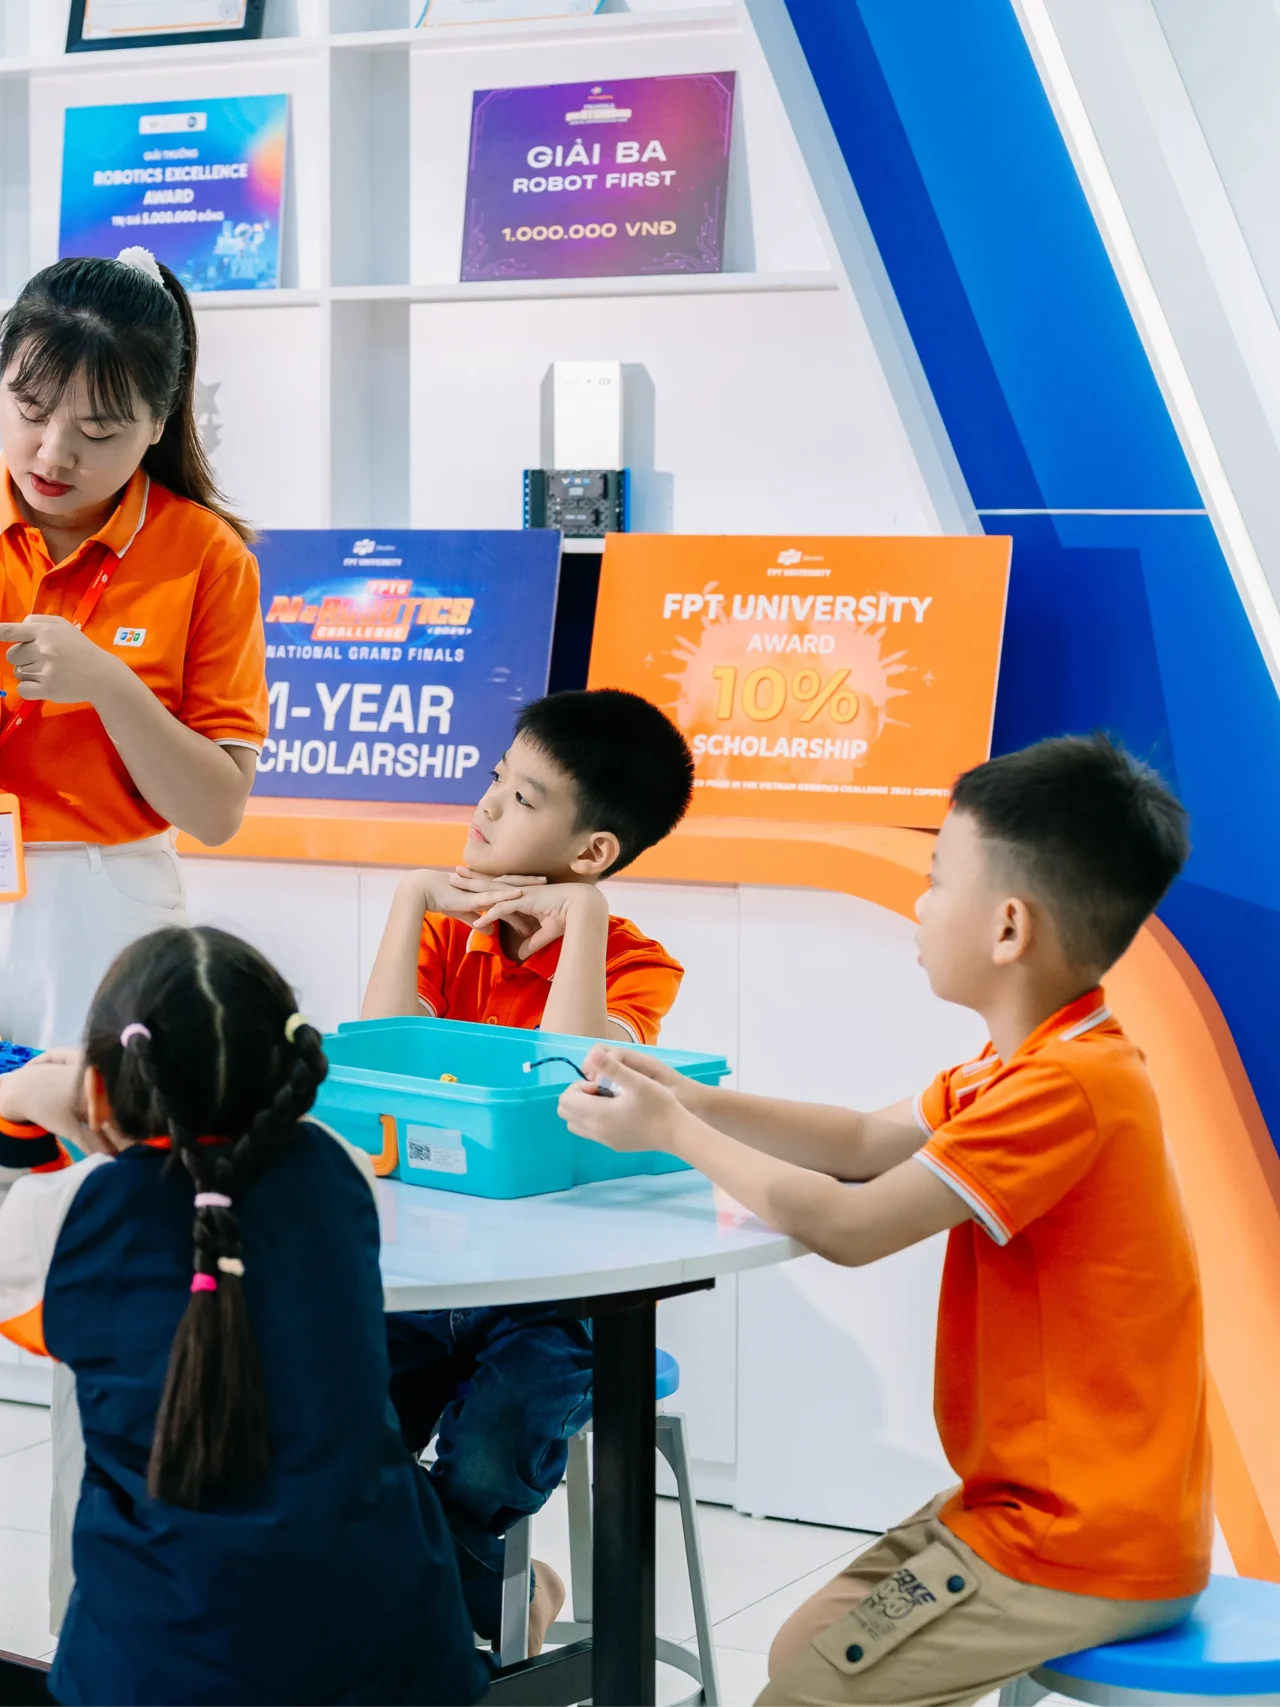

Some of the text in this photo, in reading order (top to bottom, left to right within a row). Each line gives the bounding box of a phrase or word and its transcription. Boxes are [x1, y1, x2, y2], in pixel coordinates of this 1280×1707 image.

[527, 138, 667, 169] GIẢI BA
[93, 163, 248, 187] ROBOTICS EXCELLENCE
[512, 170, 676, 193] ROBOT FIRST
[142, 188, 194, 206] AWARD
[501, 223, 617, 242] 1.000.000
[663, 593, 933, 624] FPT UNIVERSITY
[266, 645, 465, 663] NATIONAL GRAND FINALS
[745, 633, 836, 655] AWARD
[712, 665, 860, 724] 10%
[255, 738, 480, 779] CHOLARSHIP
[692, 733, 868, 760] SCHOLARSHIP
